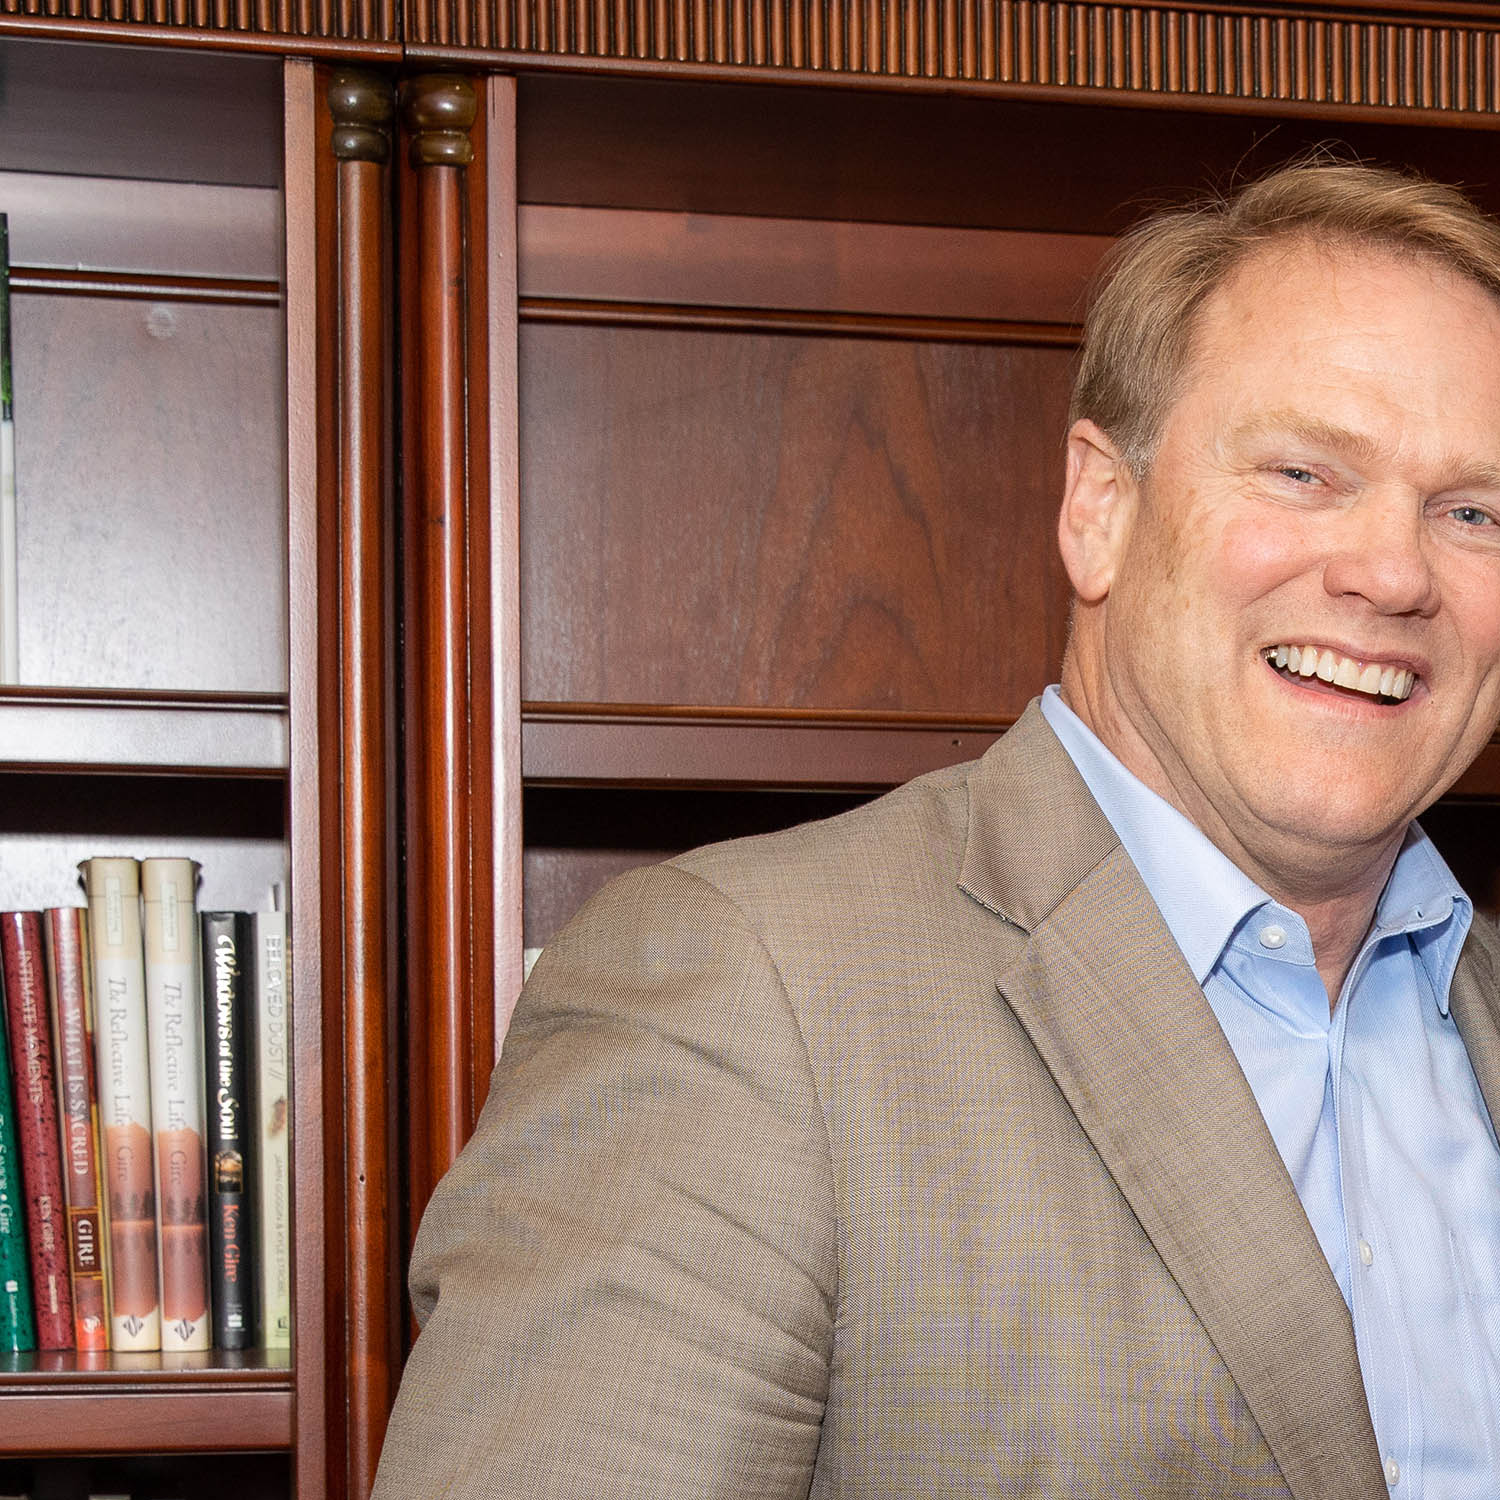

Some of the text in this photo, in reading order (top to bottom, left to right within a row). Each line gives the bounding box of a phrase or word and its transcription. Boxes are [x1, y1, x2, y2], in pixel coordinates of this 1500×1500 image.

[215, 935, 241, 1040] Windows
[18, 950, 44, 1105] INTIMATE MOMENTS
[64, 1007, 85, 1071] WHAT
[108, 977, 130, 1126] The Reflective Life
[164, 982, 186, 1131] The Reflective Life
[267, 1022, 283, 1065] DUST
[70, 1100, 91, 1175] SACRED
[217, 1087, 240, 1140] Soul
[116, 1146, 134, 1180] Gire
[170, 1150, 188, 1184] Gire
[41, 1222, 55, 1252] GIRE
[77, 1219, 96, 1267] GIRE
[223, 1203, 240, 1282] Ken Gire
